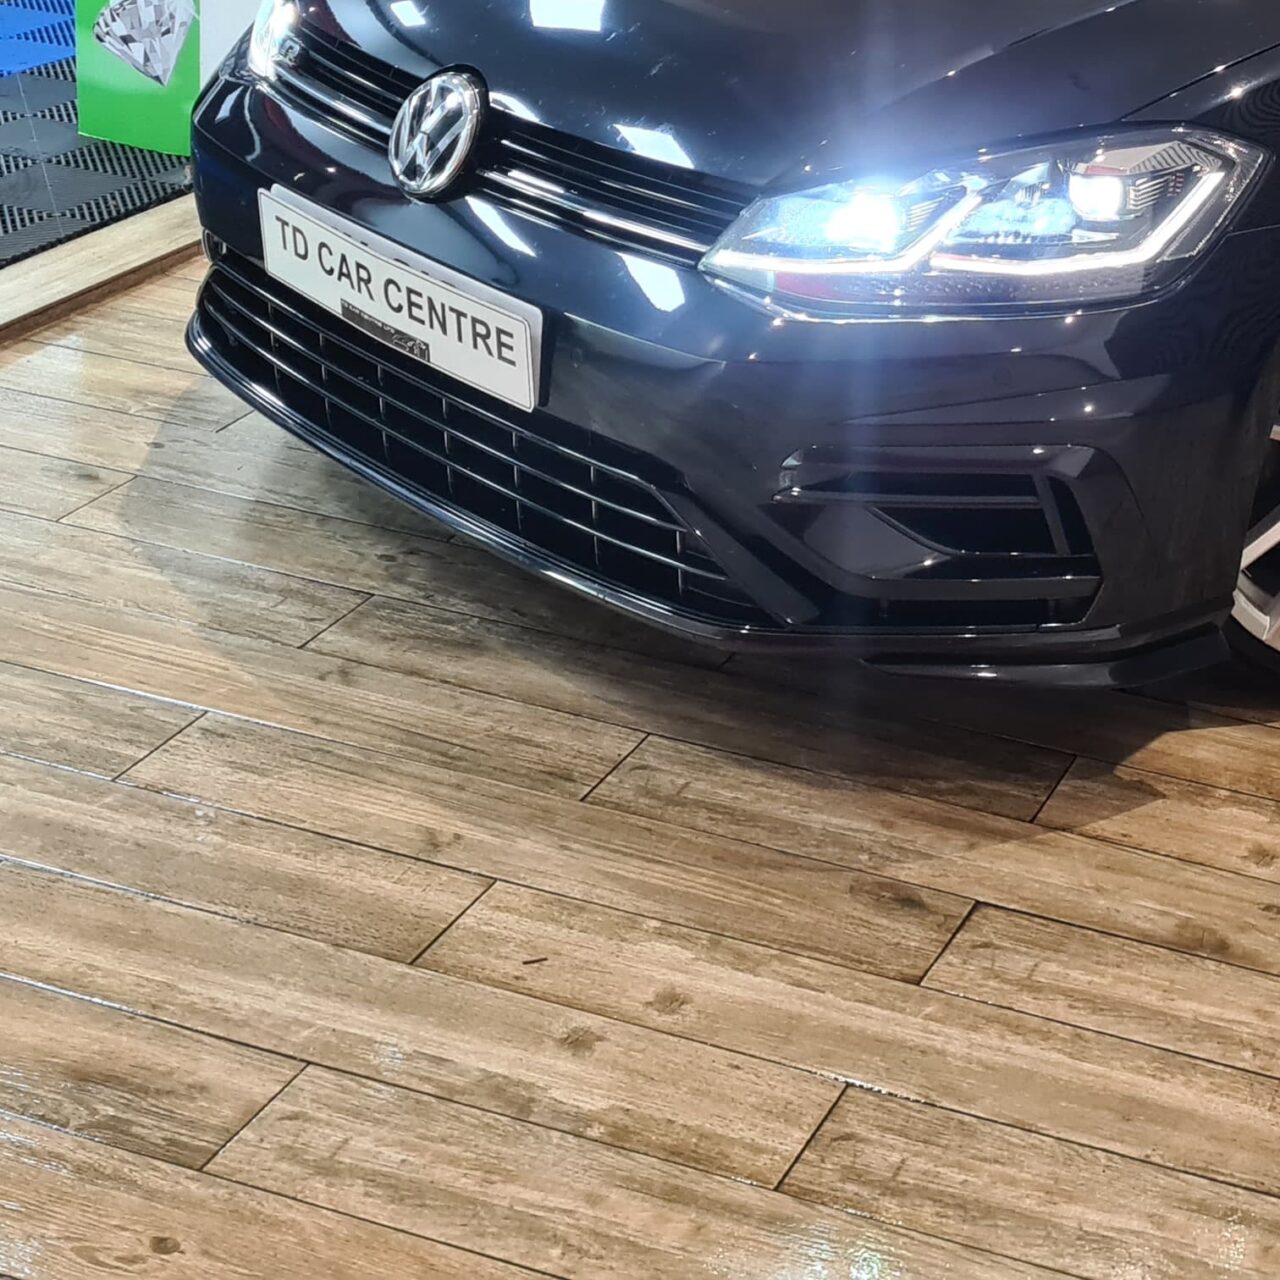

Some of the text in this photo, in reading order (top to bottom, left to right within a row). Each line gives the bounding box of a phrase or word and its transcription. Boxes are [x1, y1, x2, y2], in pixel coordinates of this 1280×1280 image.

[275, 214, 309, 261] TD
[317, 240, 376, 302] CAR
[383, 277, 517, 367] CENTRE
